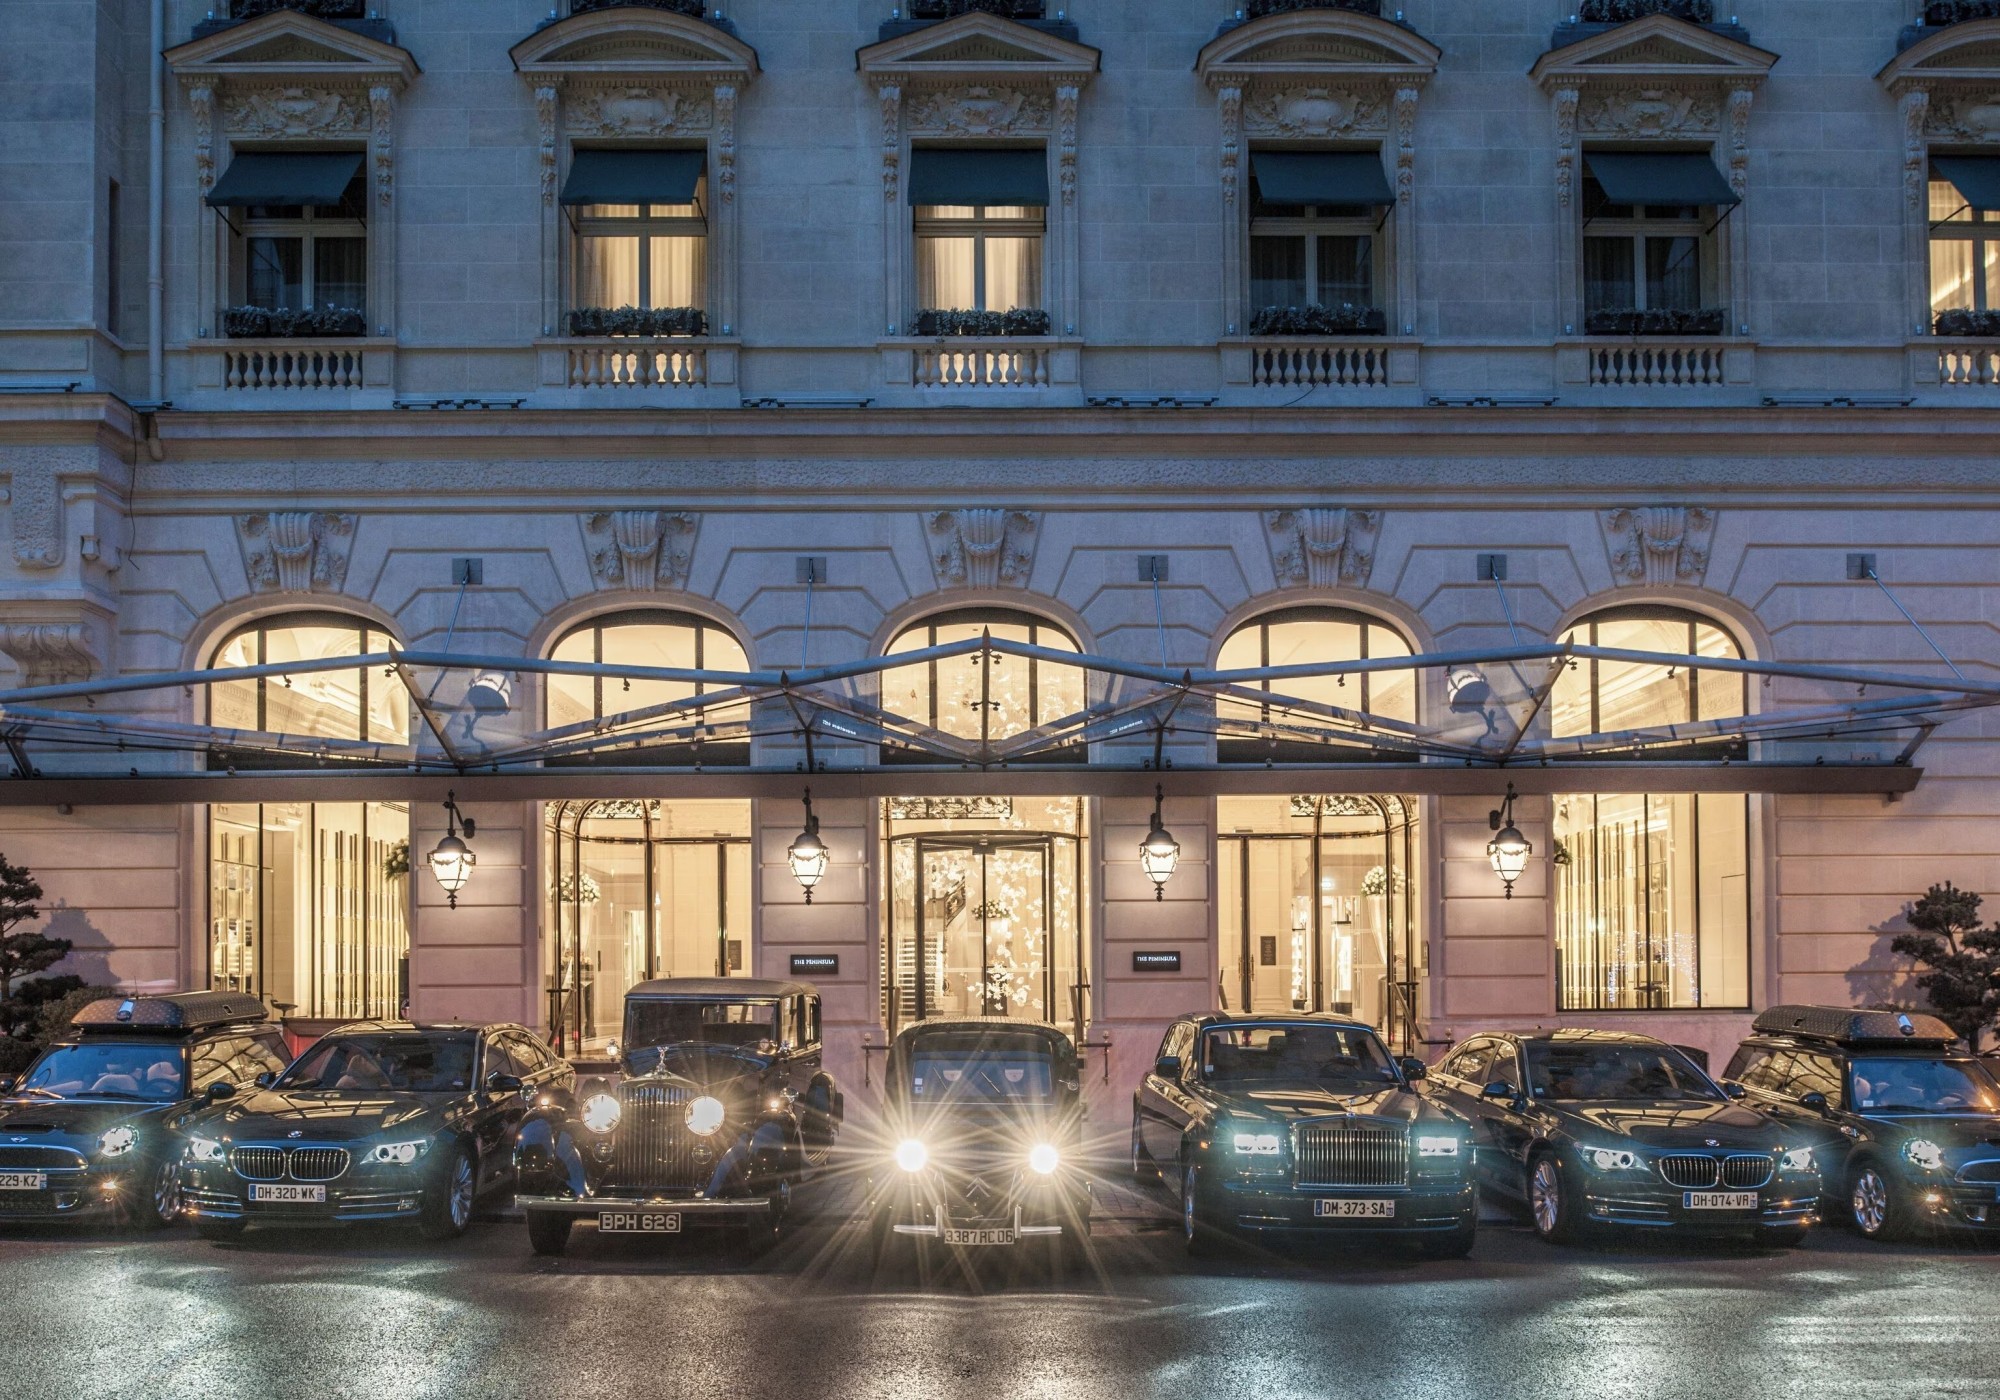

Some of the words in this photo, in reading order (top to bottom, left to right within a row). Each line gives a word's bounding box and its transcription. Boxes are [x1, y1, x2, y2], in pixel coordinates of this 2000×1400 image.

[257, 1187, 315, 1199] DH-320-WK
[1323, 1201, 1386, 1215] DM-373-SA
[602, 1214, 637, 1229] BPH
[642, 1214, 677, 1229] 626
[945, 1230, 977, 1244] 3387
[997, 1230, 1013, 1243] 06
